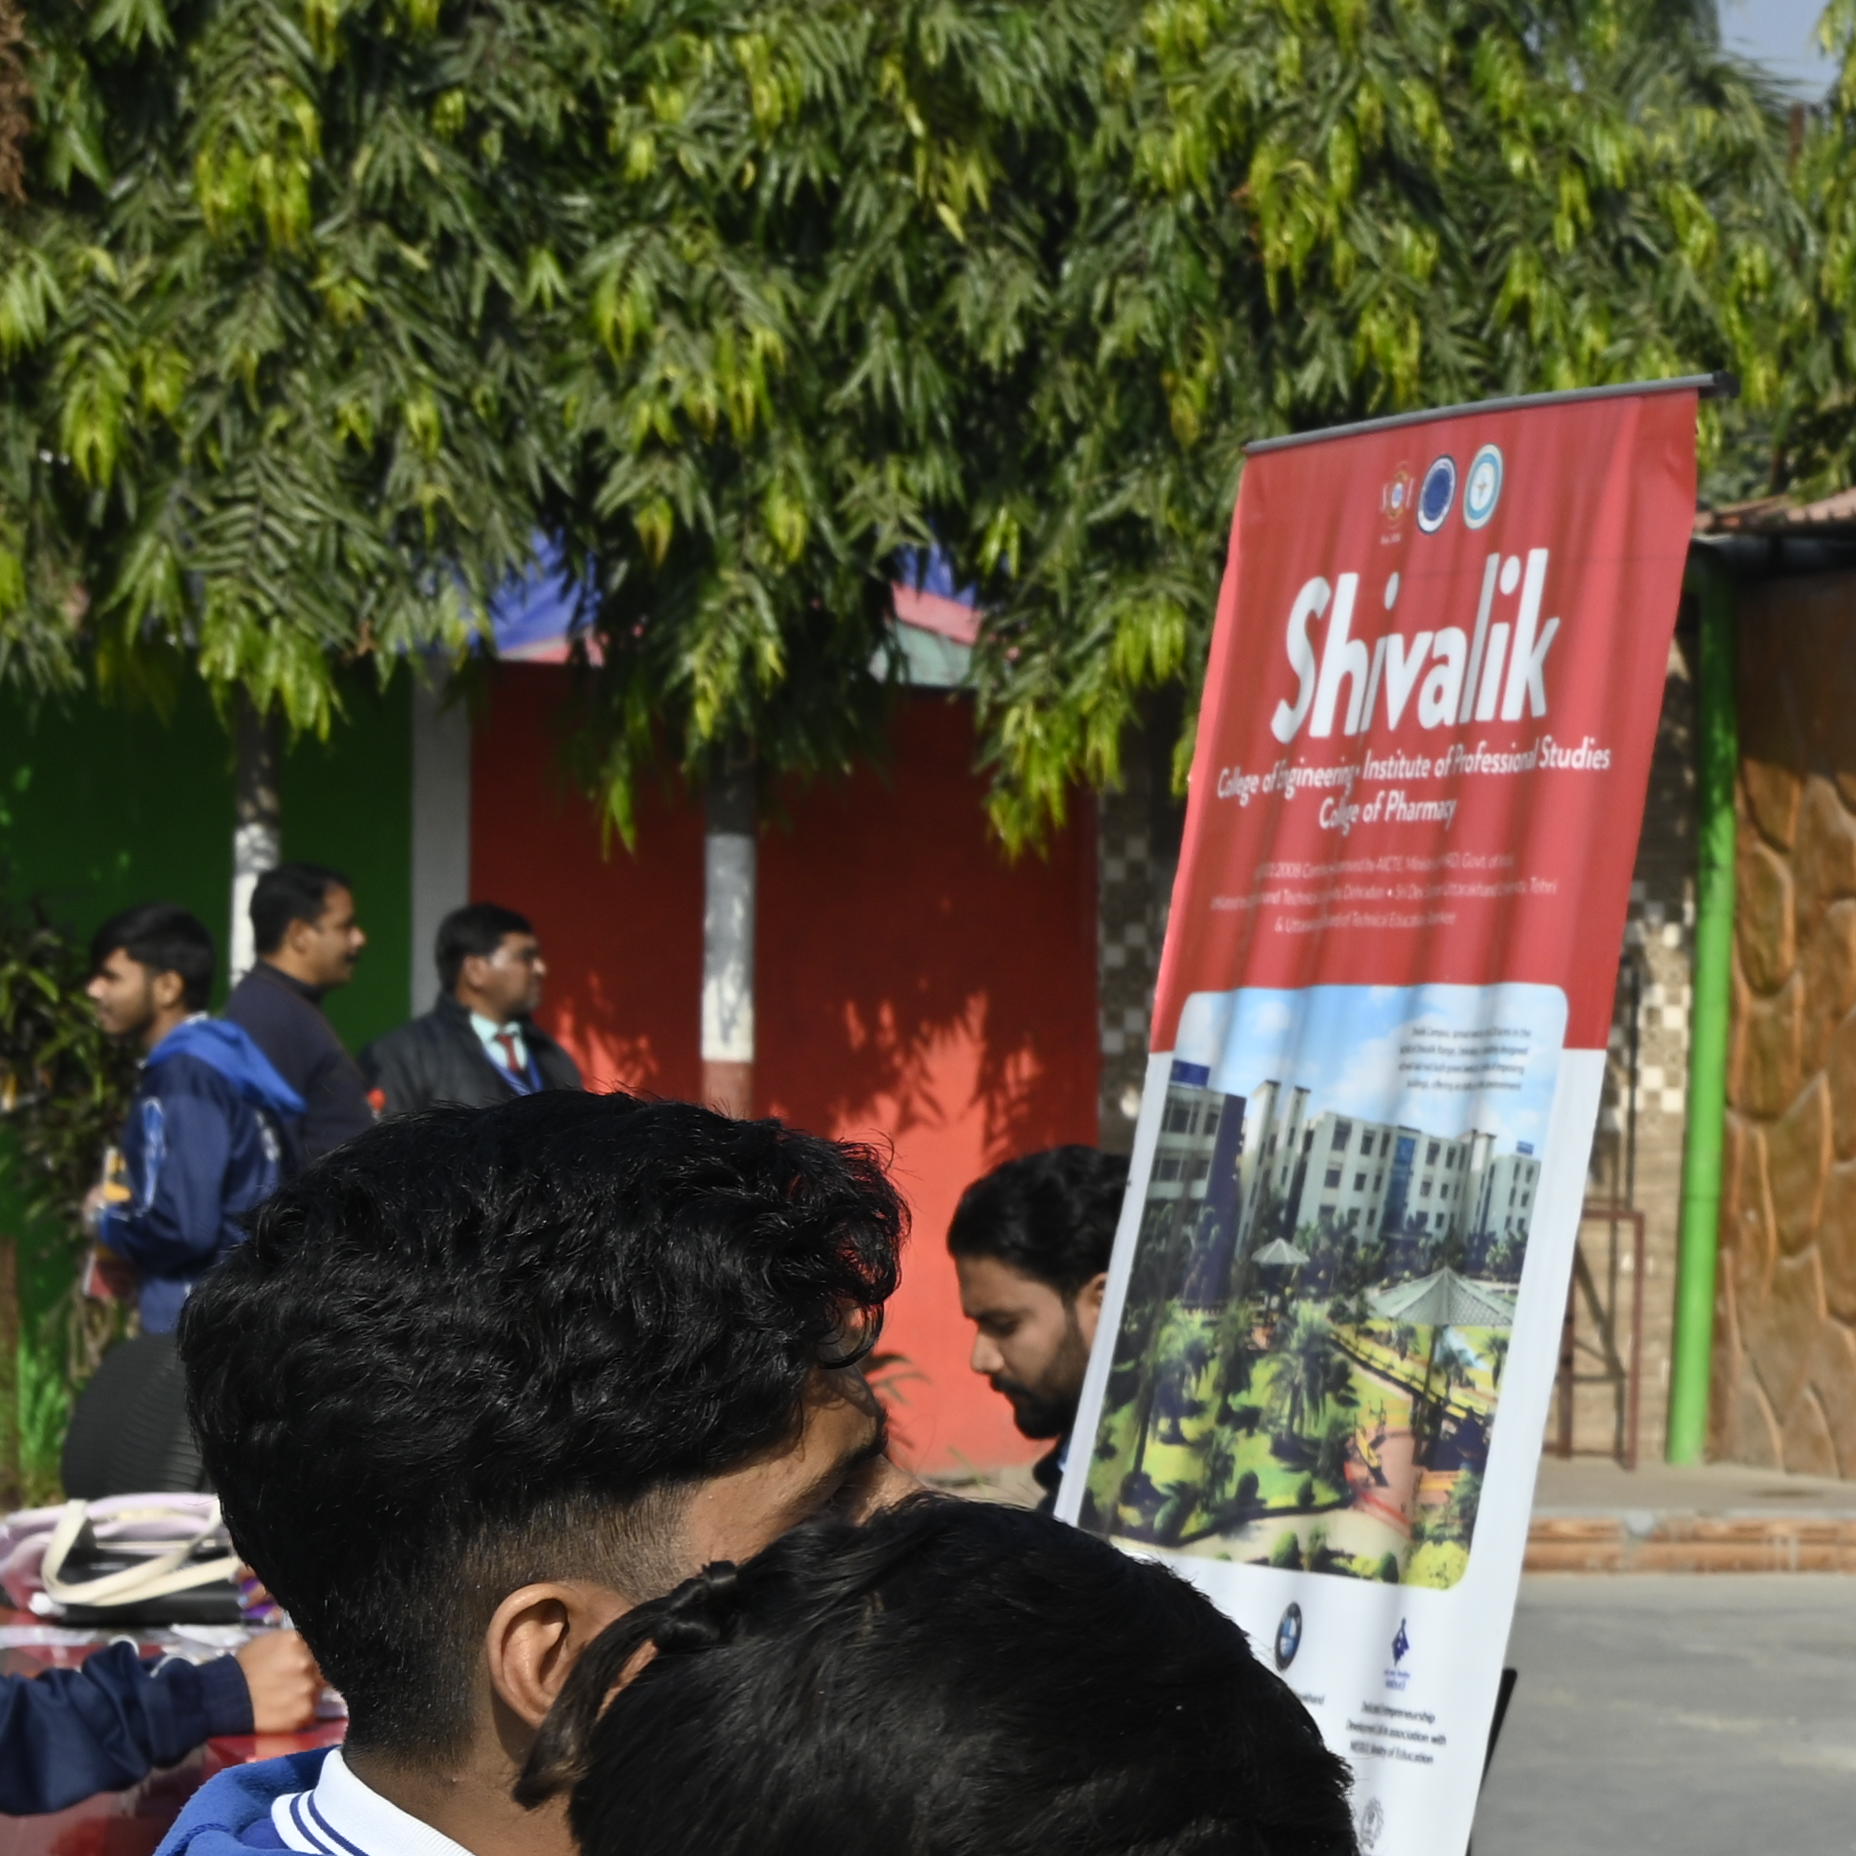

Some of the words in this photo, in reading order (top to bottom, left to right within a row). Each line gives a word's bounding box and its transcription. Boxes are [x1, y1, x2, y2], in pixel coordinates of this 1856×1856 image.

[1270, 548, 1560, 744] Shivalik
[1217, 766, 1259, 806] College
[1363, 748, 1430, 779] Institute
[1435, 744, 1455, 778] of
[1453, 738, 1538, 774] Professional
[1539, 735, 1611, 769] Studies
[1363, 792, 1384, 823] of
[1384, 789, 1457, 830] Pharmacy
